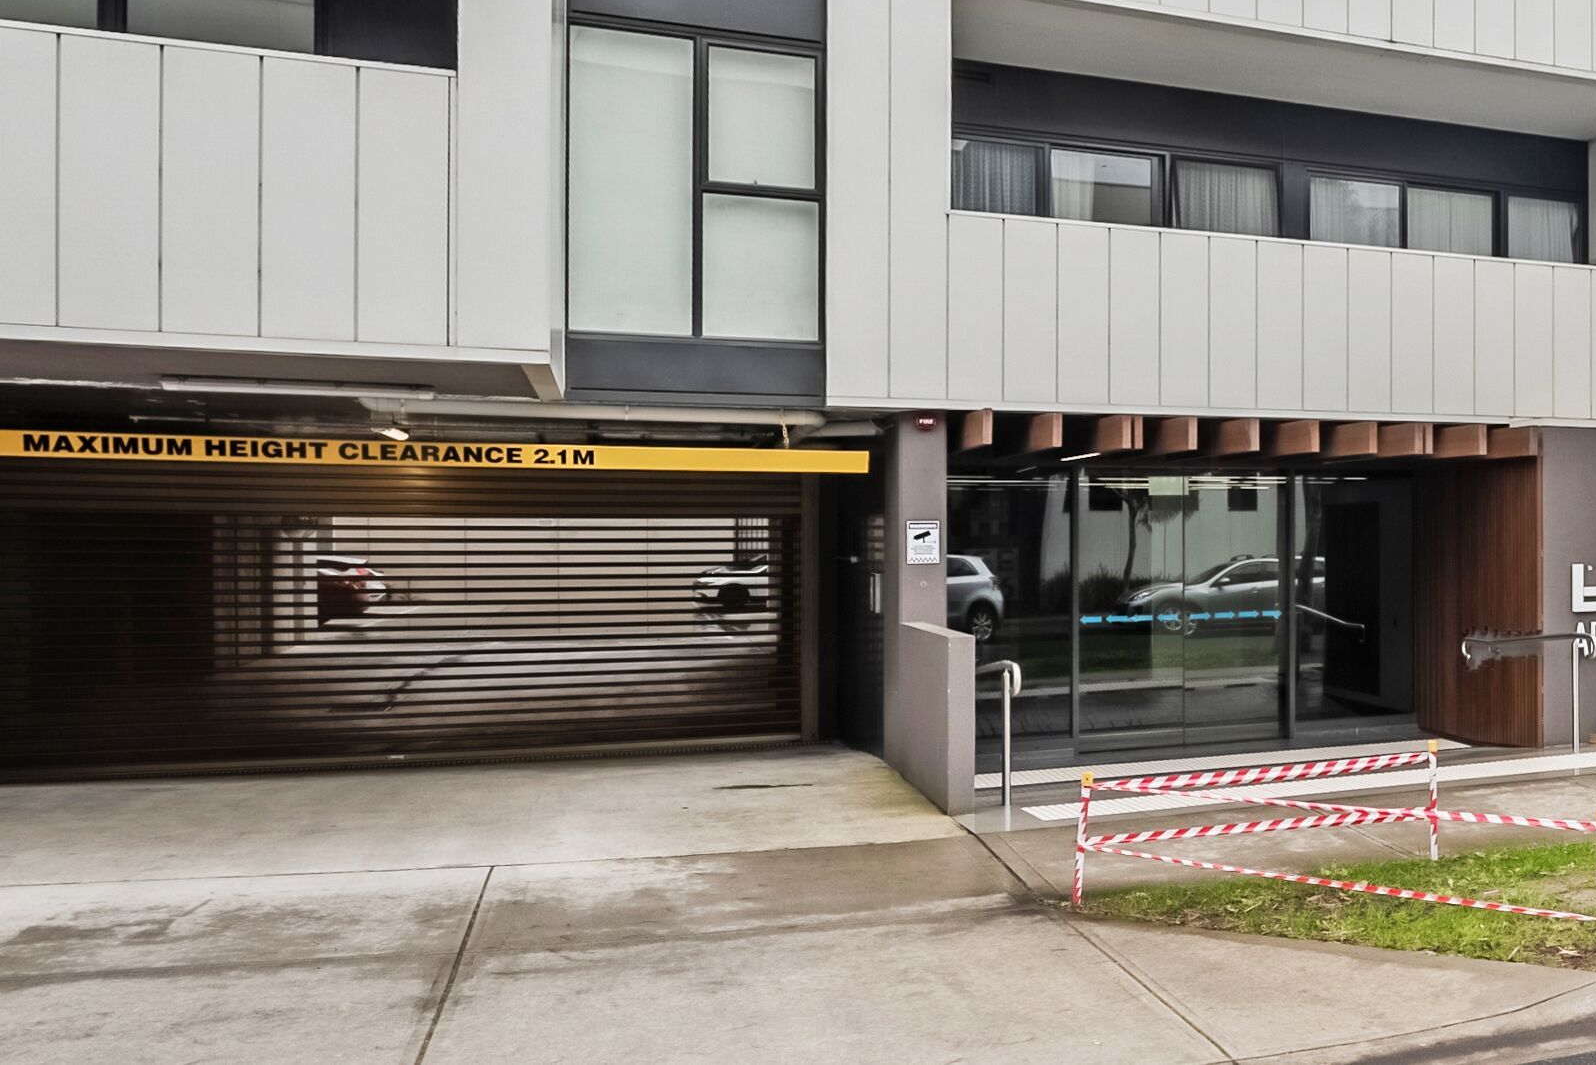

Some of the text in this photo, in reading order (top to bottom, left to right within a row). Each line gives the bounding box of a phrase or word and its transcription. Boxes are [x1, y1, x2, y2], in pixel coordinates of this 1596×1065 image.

[22, 433, 595, 465] MAXIMUM HEIGHT CLEARANCE 2.1M
